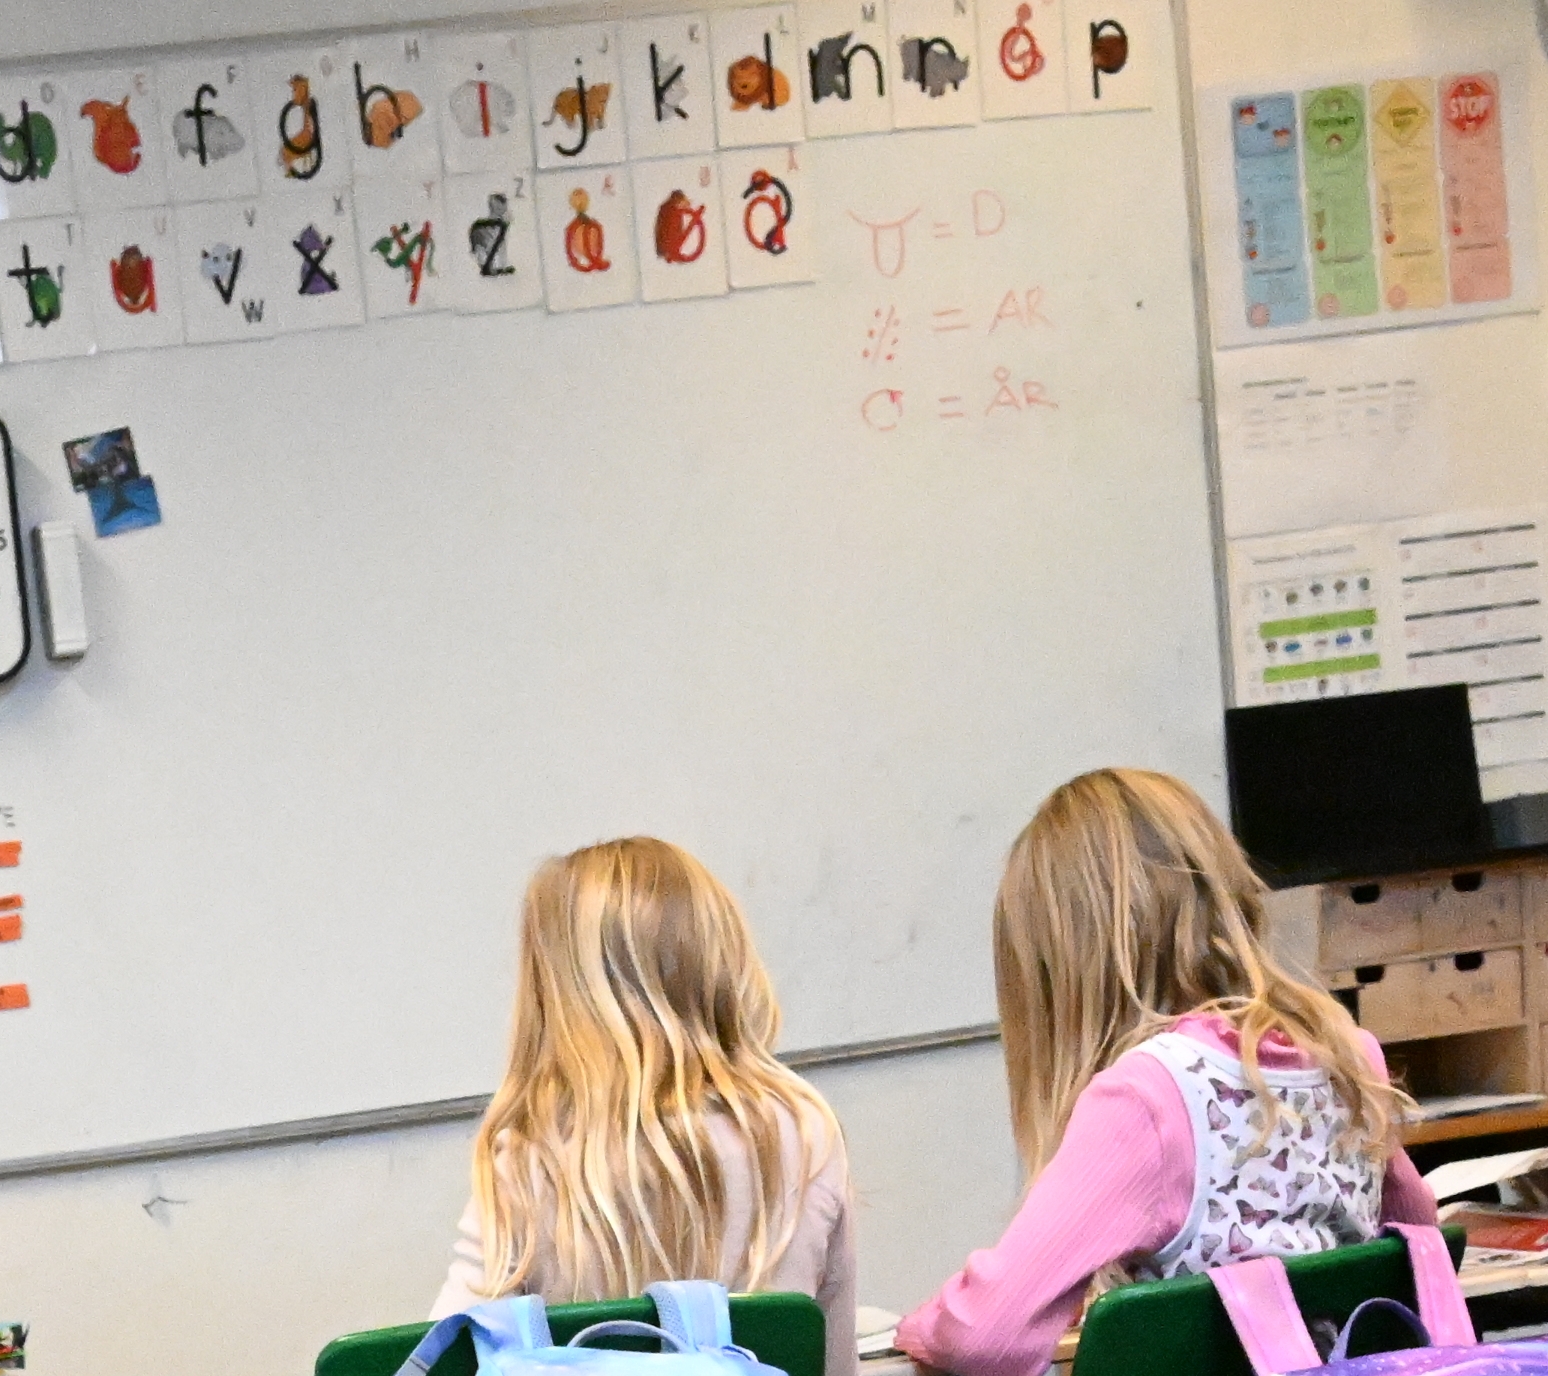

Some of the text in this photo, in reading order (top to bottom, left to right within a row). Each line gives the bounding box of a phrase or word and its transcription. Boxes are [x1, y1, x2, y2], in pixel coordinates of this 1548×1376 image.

[405, 38, 420, 62] H
[183, 83, 219, 168] f
[278, 96, 324, 181] g
[353, 60, 406, 148] h
[474, 60, 492, 139] i
[554, 57, 590, 157] j
[649, 40, 690, 124] k
[762, 31, 777, 112] l
[808, 41, 886, 104] m
[916, 36, 960, 95] n
[1089, 17, 1130, 100] p
[513, 176, 526, 198] Z
[7, 243, 62, 328] t
[109, 256, 157, 315] u
[212, 247, 243, 306] v
[291, 234, 341, 296] x
[467, 216, 516, 277] z
